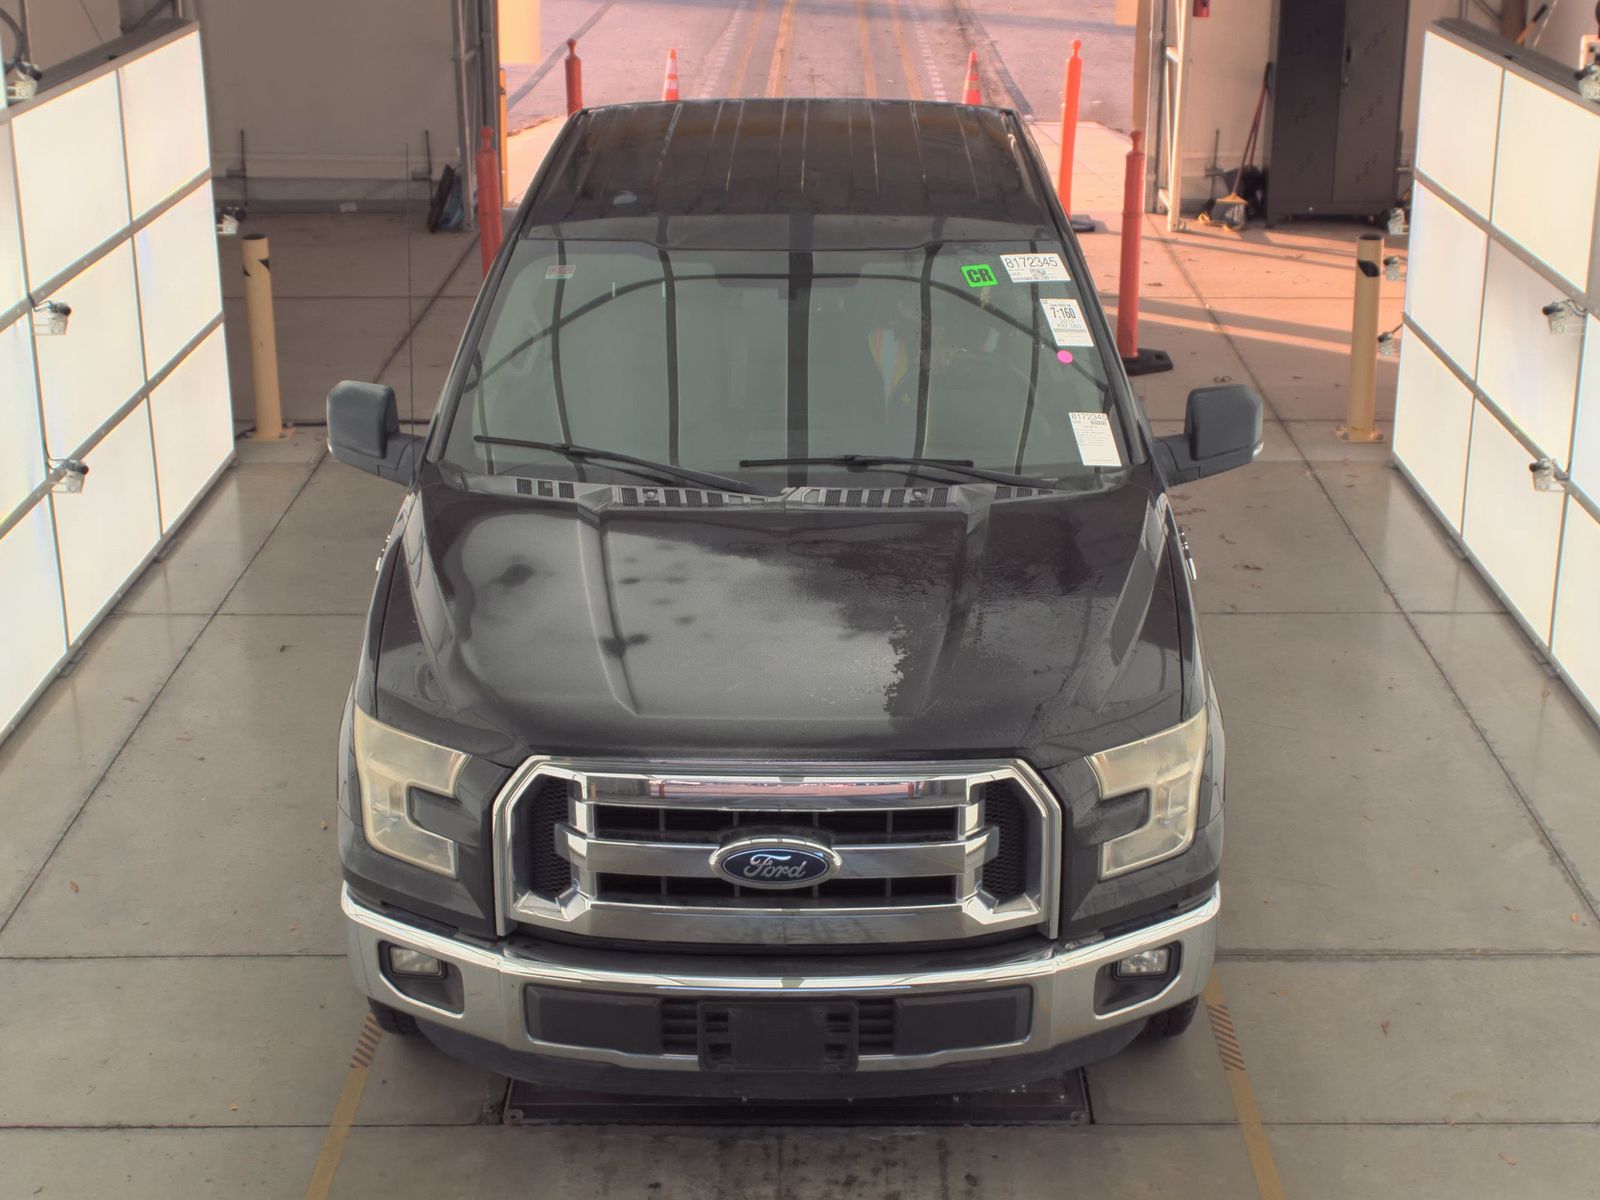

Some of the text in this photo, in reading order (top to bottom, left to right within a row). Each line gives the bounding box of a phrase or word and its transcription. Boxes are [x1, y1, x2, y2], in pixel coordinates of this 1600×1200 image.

[1004, 256, 1058, 269] 8172345
[966, 268, 994, 283] CR
[1050, 307, 1077, 319] 7:160
[743, 853, 808, 878] Ford
